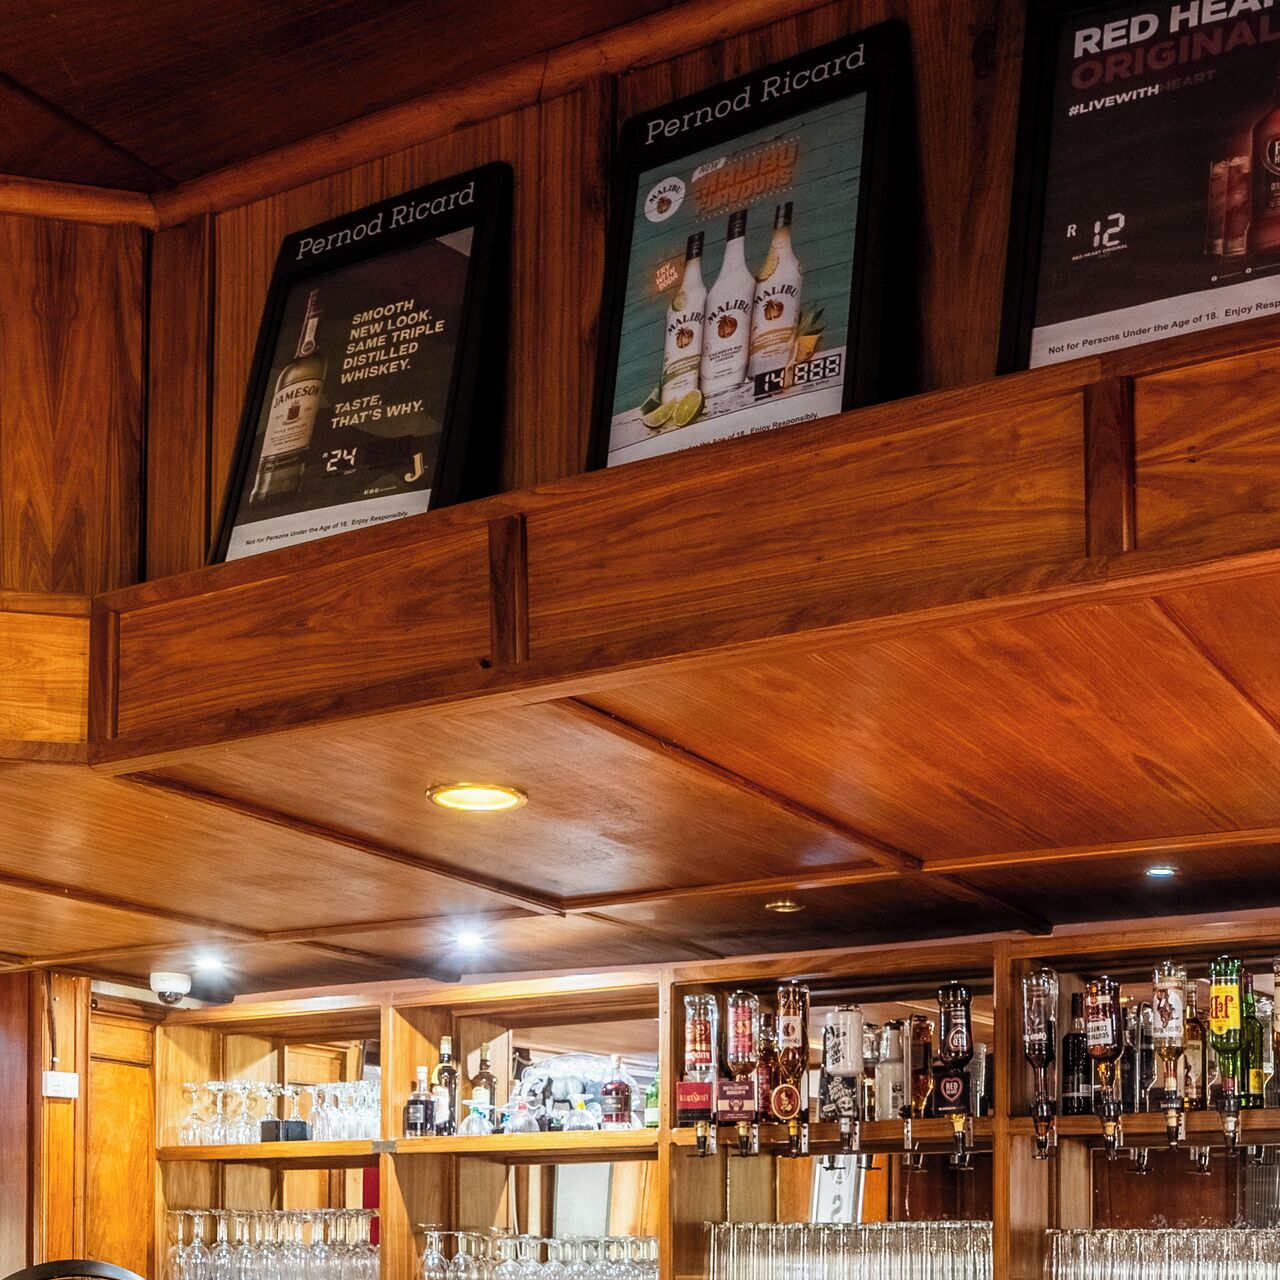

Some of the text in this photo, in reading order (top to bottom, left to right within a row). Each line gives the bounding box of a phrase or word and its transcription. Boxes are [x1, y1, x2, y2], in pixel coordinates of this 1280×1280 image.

[1074, 13, 1159, 58] RED
[645, 44, 865, 145] Pernod Ricard
[649, 181, 684, 204] MALIBU
[296, 182, 475, 260] Pernod Ricard
[1067, 212, 1125, 248] R 12
[754, 284, 798, 308] MALIBU
[349, 309, 432, 340] NEW LOOK.
[352, 299, 414, 325] SMOOTH
[668, 312, 705, 336] MALIBU
[707, 300, 750, 325] MALIBU
[346, 320, 445, 354] SAME TRIPLE
[1048, 346, 1065, 355] Not
[1066, 342, 1080, 351] for
[1082, 334, 1120, 348] Persons
[1122, 327, 1151, 338] Under
[1154, 323, 1169, 332] the
[1171, 319, 1190, 329] Age
[1192, 315, 1203, 324] of
[1205, 311, 1219, 321] 18.
[1224, 305, 1253, 318] Enjoy
[343, 342, 418, 370] DISTILLED
[341, 359, 411, 384] WHISKEY.
[274, 385, 320, 408] JAMESON
[335, 395, 382, 414] TASTE,
[331, 400, 424, 429] THAT'S WHY.
[326, 447, 357, 472] 24
[246, 537, 256, 546] Not
[256, 535, 265, 544] for
[265, 532, 289, 543] Persons
[290, 527, 308, 537] Under
[319, 523, 331, 533] Age
[332, 520, 339, 529] of
[351, 516, 369, 527] Enjoy
[945, 1081, 958, 1090] RED
